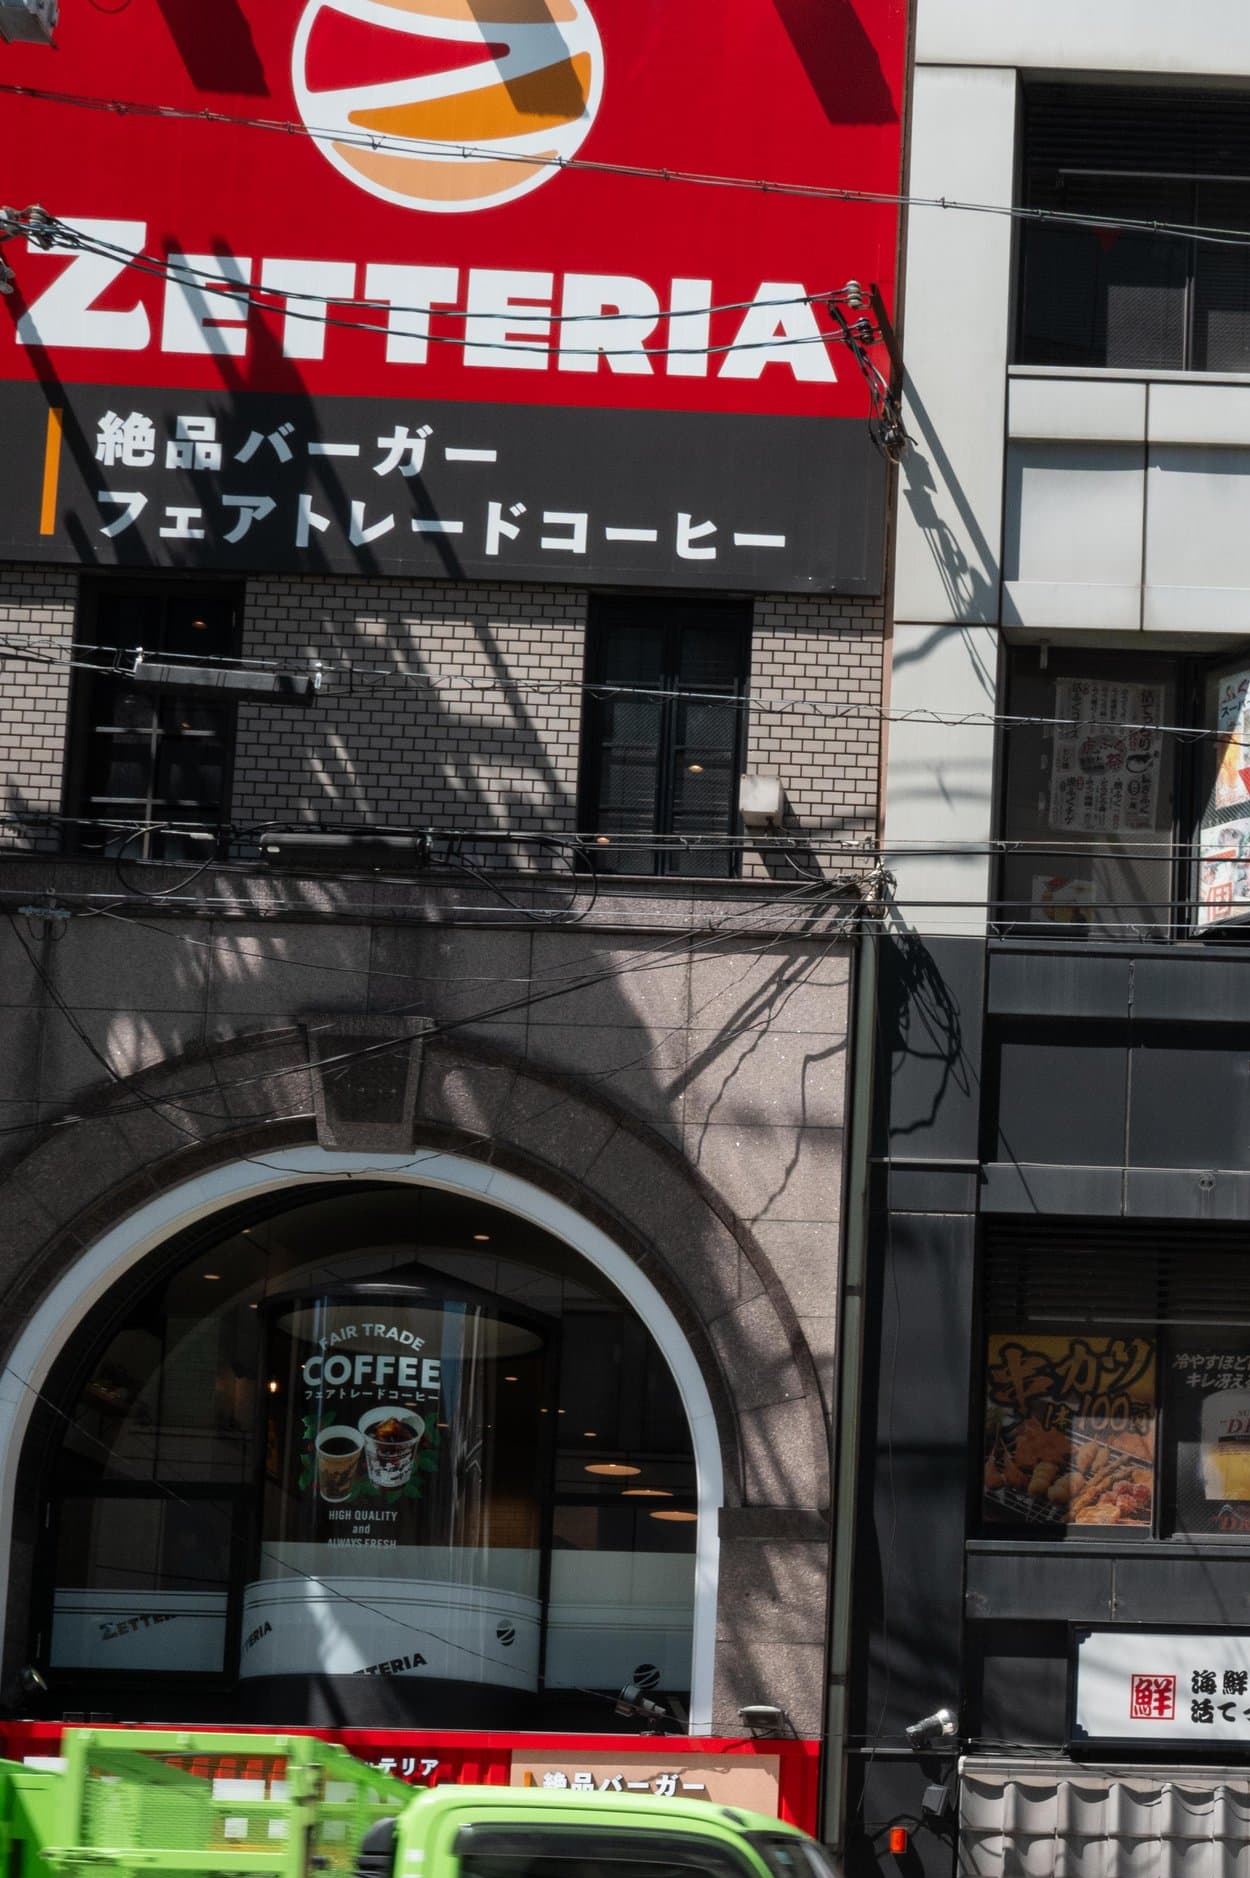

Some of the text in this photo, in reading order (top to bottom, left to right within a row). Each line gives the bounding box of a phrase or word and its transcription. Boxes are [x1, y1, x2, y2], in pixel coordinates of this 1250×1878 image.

[15, 217, 839, 384] ZETTERIA
[96, 411, 499, 477] 絶品バーガー
[97, 490, 787, 561] フェアトレードコーヒー
[318, 1323, 426, 1352] FAIR TRADE
[302, 1355, 441, 1390] COFFEE
[304, 1388, 440, 1402] フェアトレードコーヒー
[328, 1510, 398, 1523] HIGH QUALITY
[352, 1524, 370, 1534] and
